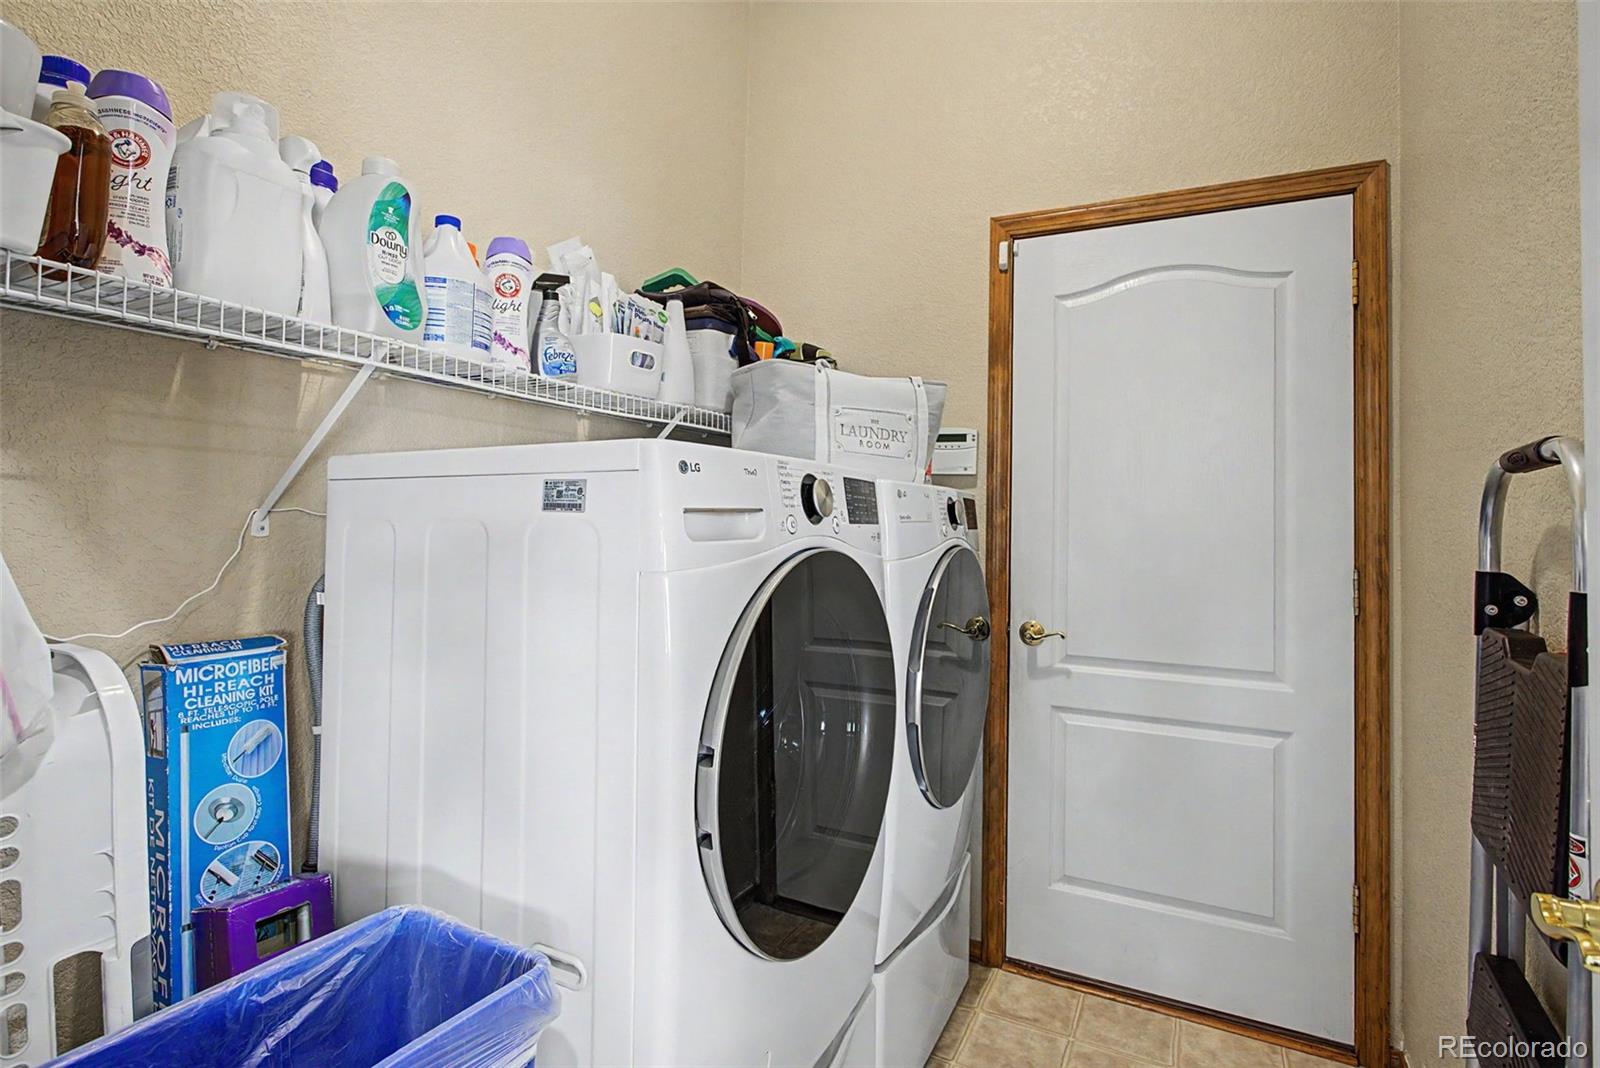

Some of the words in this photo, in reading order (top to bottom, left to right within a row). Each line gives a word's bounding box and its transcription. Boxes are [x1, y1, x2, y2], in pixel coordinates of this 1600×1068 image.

[370, 231, 408, 259] Downy
[491, 298, 522, 314] light
[543, 346, 575, 363] Febreze
[840, 423, 908, 443] LAUNDRY
[859, 439, 890, 450] ROOM
[689, 462, 701, 473] LG
[168, 640, 241, 652] HI-REACH
[172, 644, 228, 657] CLEANING
[229, 643, 243, 651] KIT
[175, 657, 278, 685] MICROFIBER
[183, 673, 275, 698] HI-REACH
[184, 689, 256, 710] CLEANING
[259, 684, 275, 697] KIT
[204, 699, 258, 715] TELESCOPIC
[259, 694, 279, 704] POLE
[181, 711, 226, 725] REACHES
[228, 707, 241, 718] UP
[242, 705, 254, 714] TO
[192, 716, 242, 731] INCLUDES:
[149, 817, 156, 848] DE
[150, 856, 159, 993] NETTOYAGE
